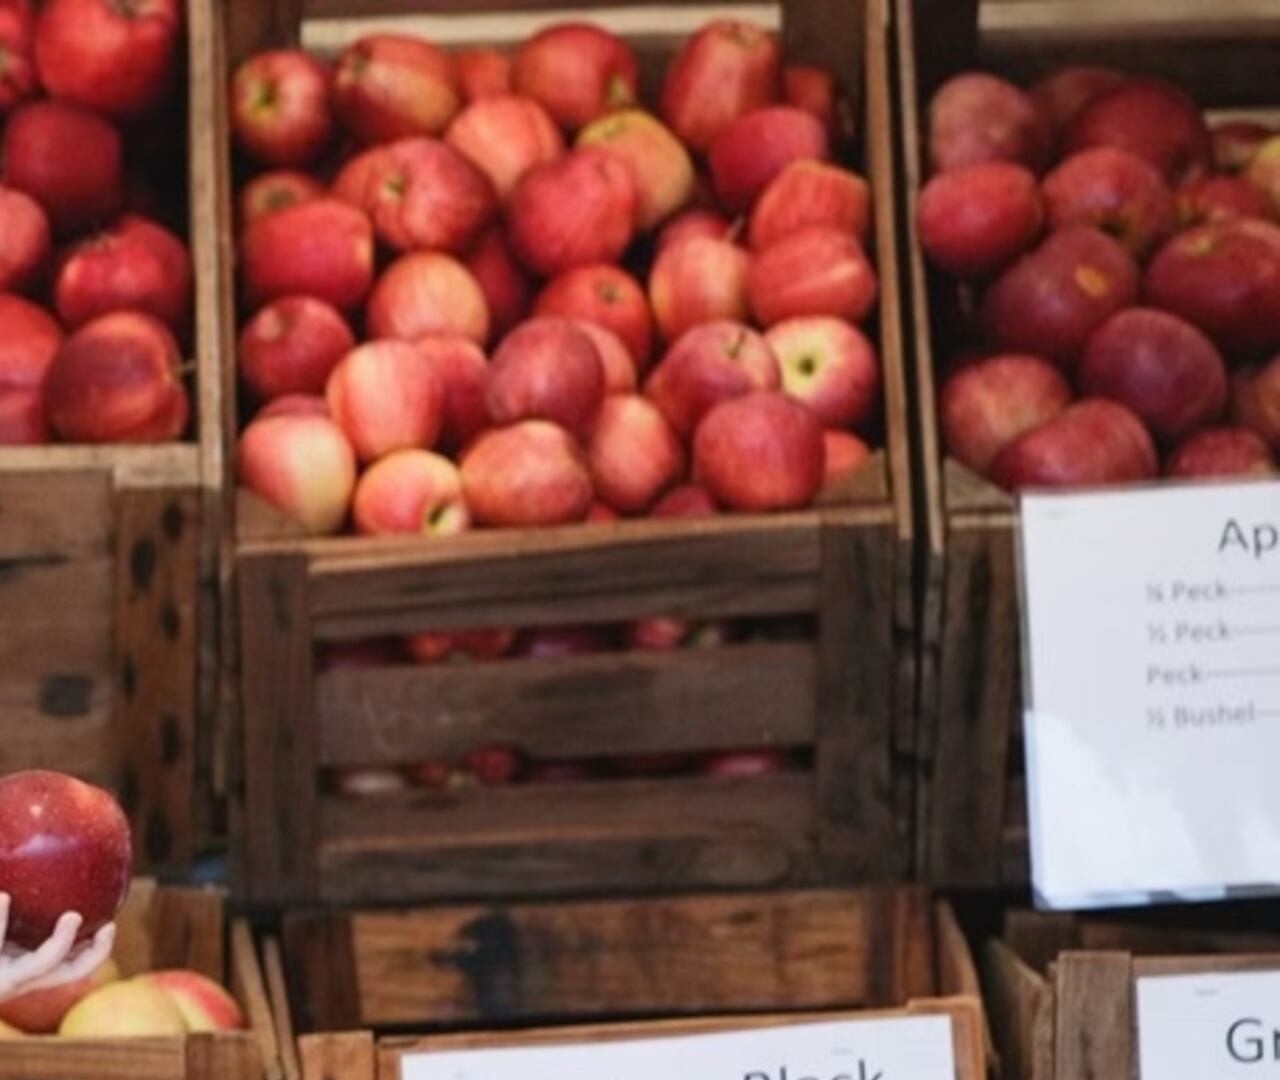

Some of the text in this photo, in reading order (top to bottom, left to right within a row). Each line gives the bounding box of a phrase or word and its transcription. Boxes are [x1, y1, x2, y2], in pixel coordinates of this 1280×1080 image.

[1218, 517, 1280, 559] Ap
[1171, 580, 1228, 602] Peck
[1174, 620, 1231, 643] Peck
[1146, 663, 1203, 686] Peck
[1173, 700, 1256, 730] Bushel
